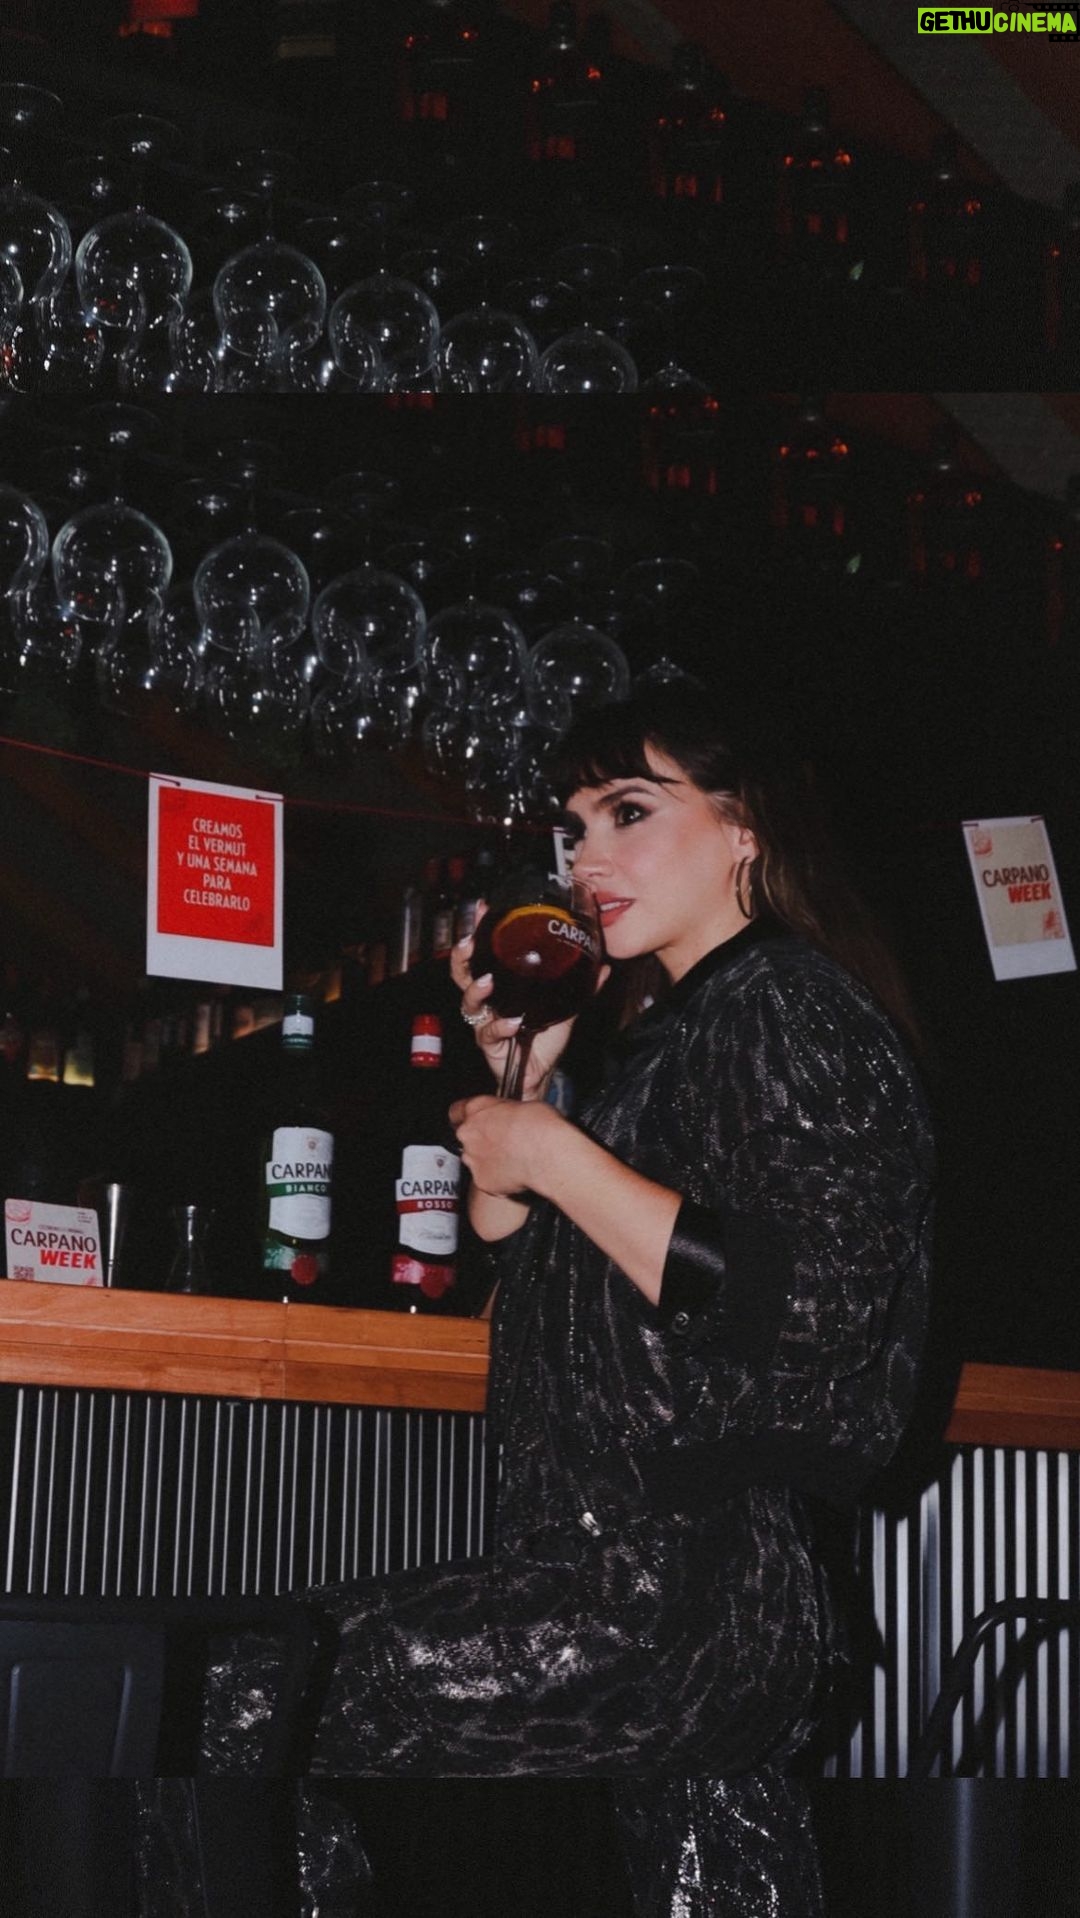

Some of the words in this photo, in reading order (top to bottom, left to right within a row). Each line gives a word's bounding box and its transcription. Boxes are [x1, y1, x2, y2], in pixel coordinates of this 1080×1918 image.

[193, 817, 243, 839] CREAMOS
[188, 835, 200, 851] EL
[203, 837, 246, 857] VERMUT
[177, 851, 184, 866] Y
[187, 853, 211, 870] UNA
[214, 856, 257, 877] SEMANA
[203, 873, 232, 891] PARA
[982, 863, 1050, 888] CARPANO
[184, 890, 251, 912] CELEBRARLO
[1007, 882, 1052, 904] WEEK
[547, 919, 597, 951] CARPA
[285, 1184, 327, 1194] BIANCO
[416, 1200, 453, 1209] ROSSO
[10, 1228, 97, 1253] CARPANO
[40, 1249, 97, 1270] WEEK
